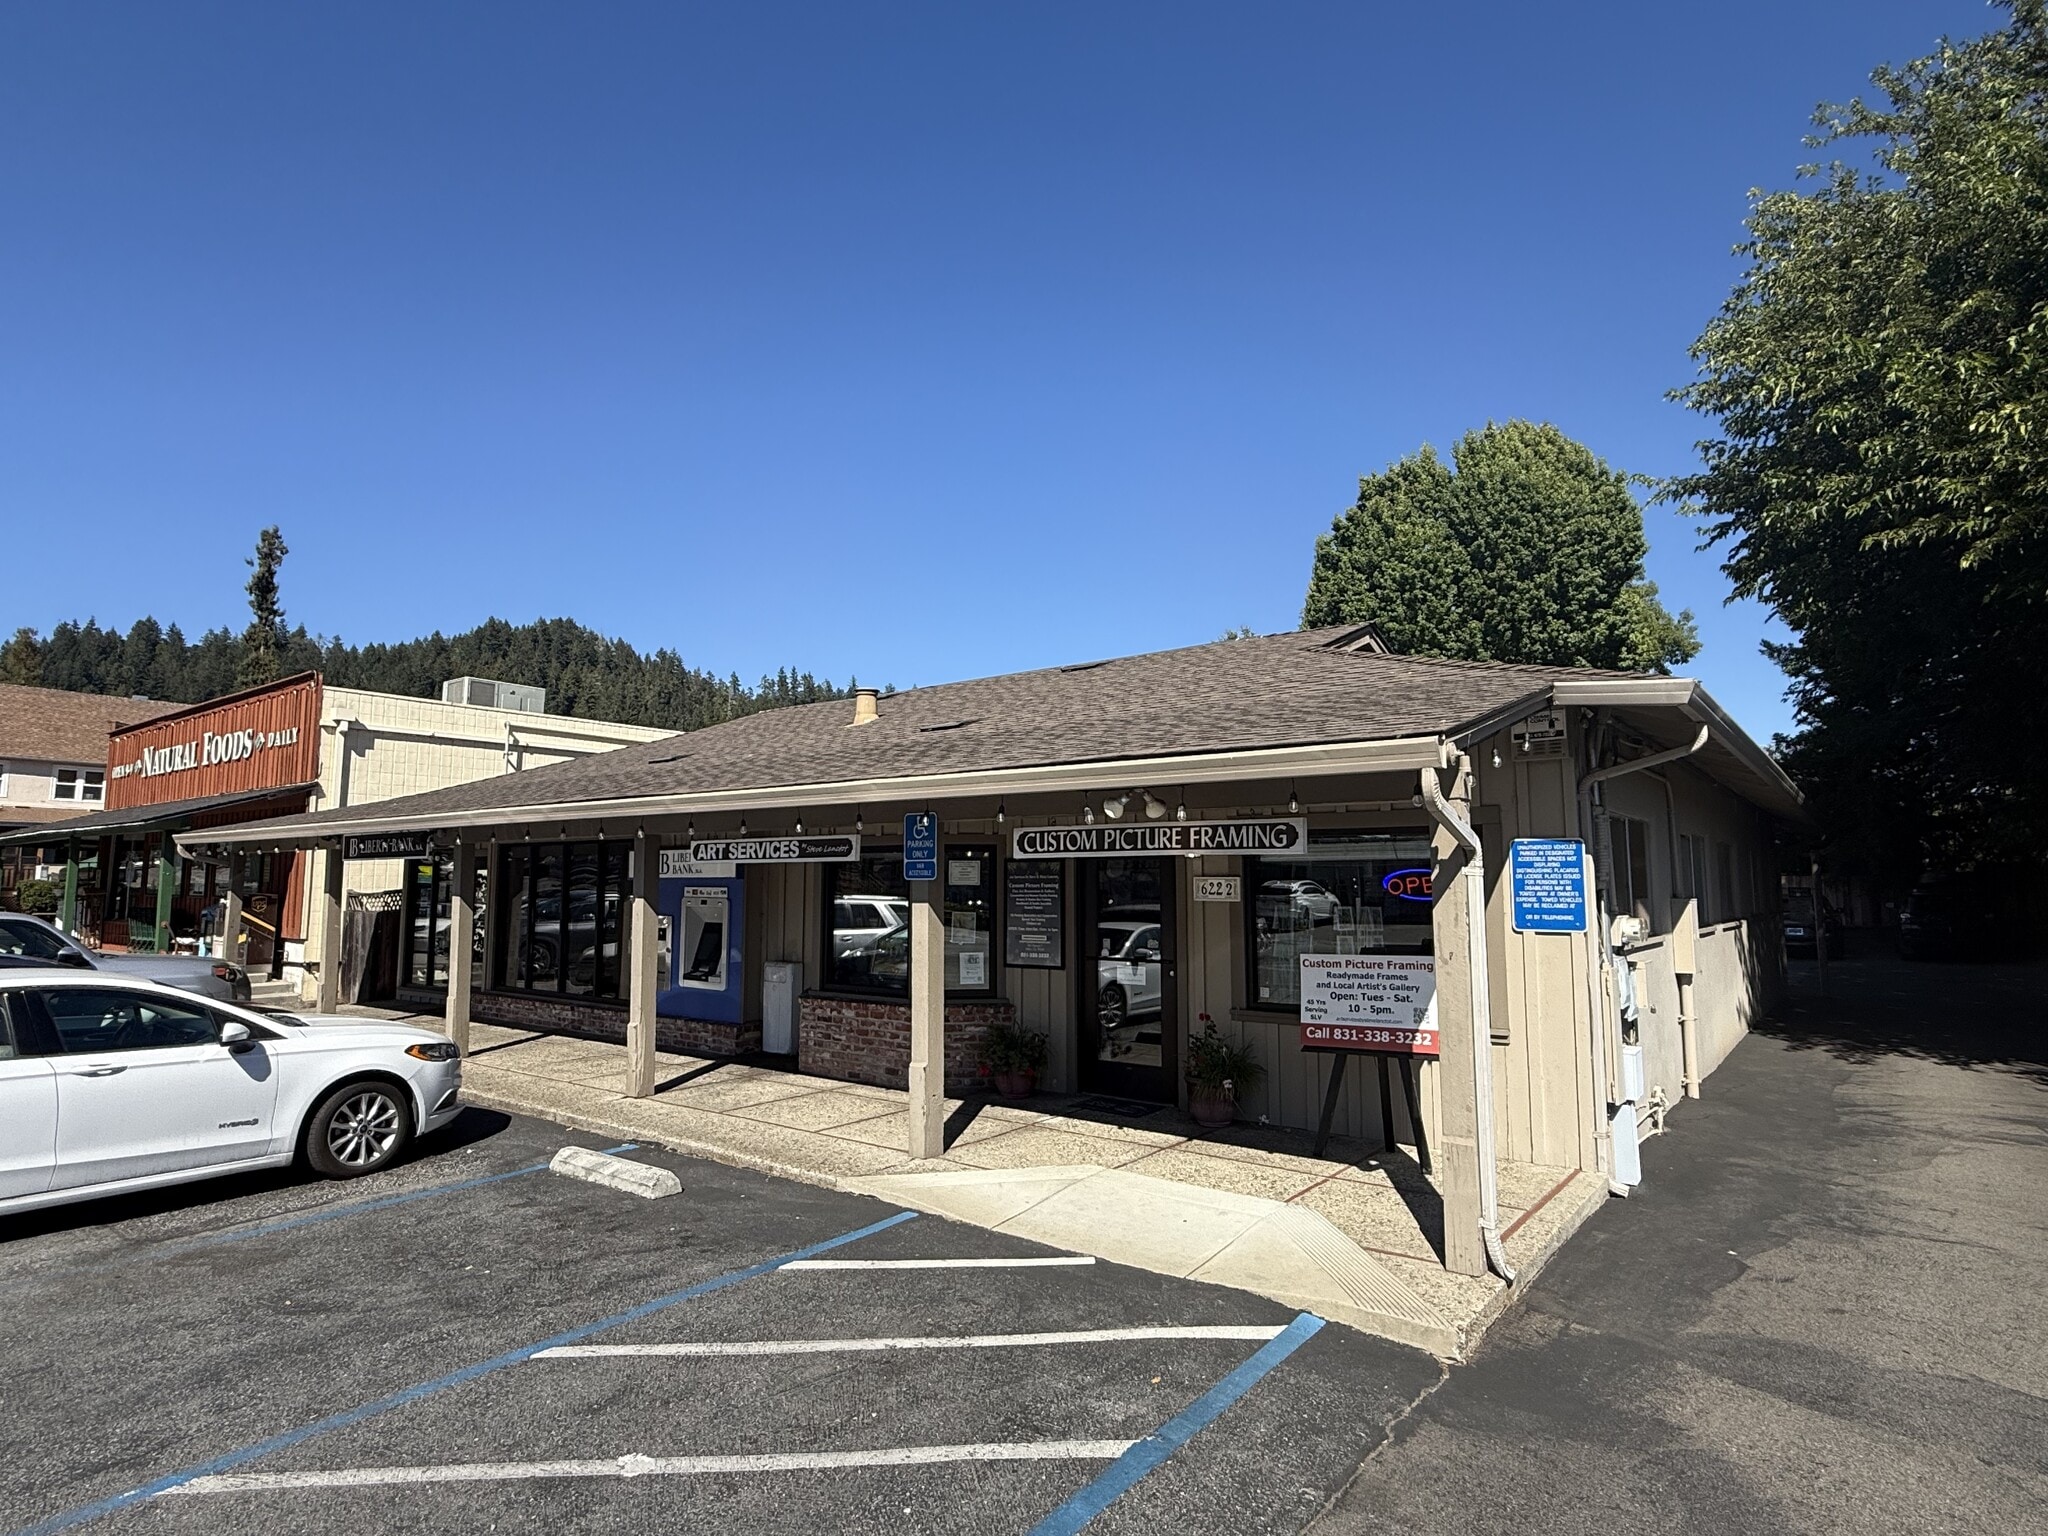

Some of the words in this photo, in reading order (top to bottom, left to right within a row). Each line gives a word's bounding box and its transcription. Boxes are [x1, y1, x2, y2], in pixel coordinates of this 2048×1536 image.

[141, 741, 199, 778] NATURAL
[201, 729, 254, 766] FOODS
[267, 727, 299, 747] DAILY
[907, 840, 934, 848] PARKING
[1024, 830, 1097, 852] CUSTOM
[1103, 827, 1182, 850] PICTURE
[1189, 824, 1287, 848] FRAMING
[697, 843, 726, 860] ART
[728, 840, 800, 859] SERVICES
[912, 850, 928, 858] ONLY
[672, 853, 691, 863] LIBE
[672, 864, 694, 875] BANK
[1201, 881, 1233, 896] 6222
[1388, 877, 1432, 894] OPE
[1302, 959, 1342, 969] Custom
[1345, 960, 1384, 970] Picture
[1387, 960, 1434, 972] Framing
[1326, 972, 1375, 980] Readymade
[1377, 973, 1409, 981] Frames
[1316, 981, 1331, 989] and
[1333, 982, 1355, 990] Local
[1357, 983, 1387, 991] Artist's
[1389, 984, 1420, 993] Gallery
[1330, 992, 1358, 1002] Open:
[1361, 993, 1384, 1002] Tues
[1394, 994, 1414, 1003] Sat.
[1304, 1006, 1328, 1014] Serving
[1348, 1004, 1360, 1013] 10
[1370, 1005, 1395, 1016] 5pm.
[1306, 1027, 1330, 1039] Call
[1333, 1028, 1432, 1045] 831-338-3232
